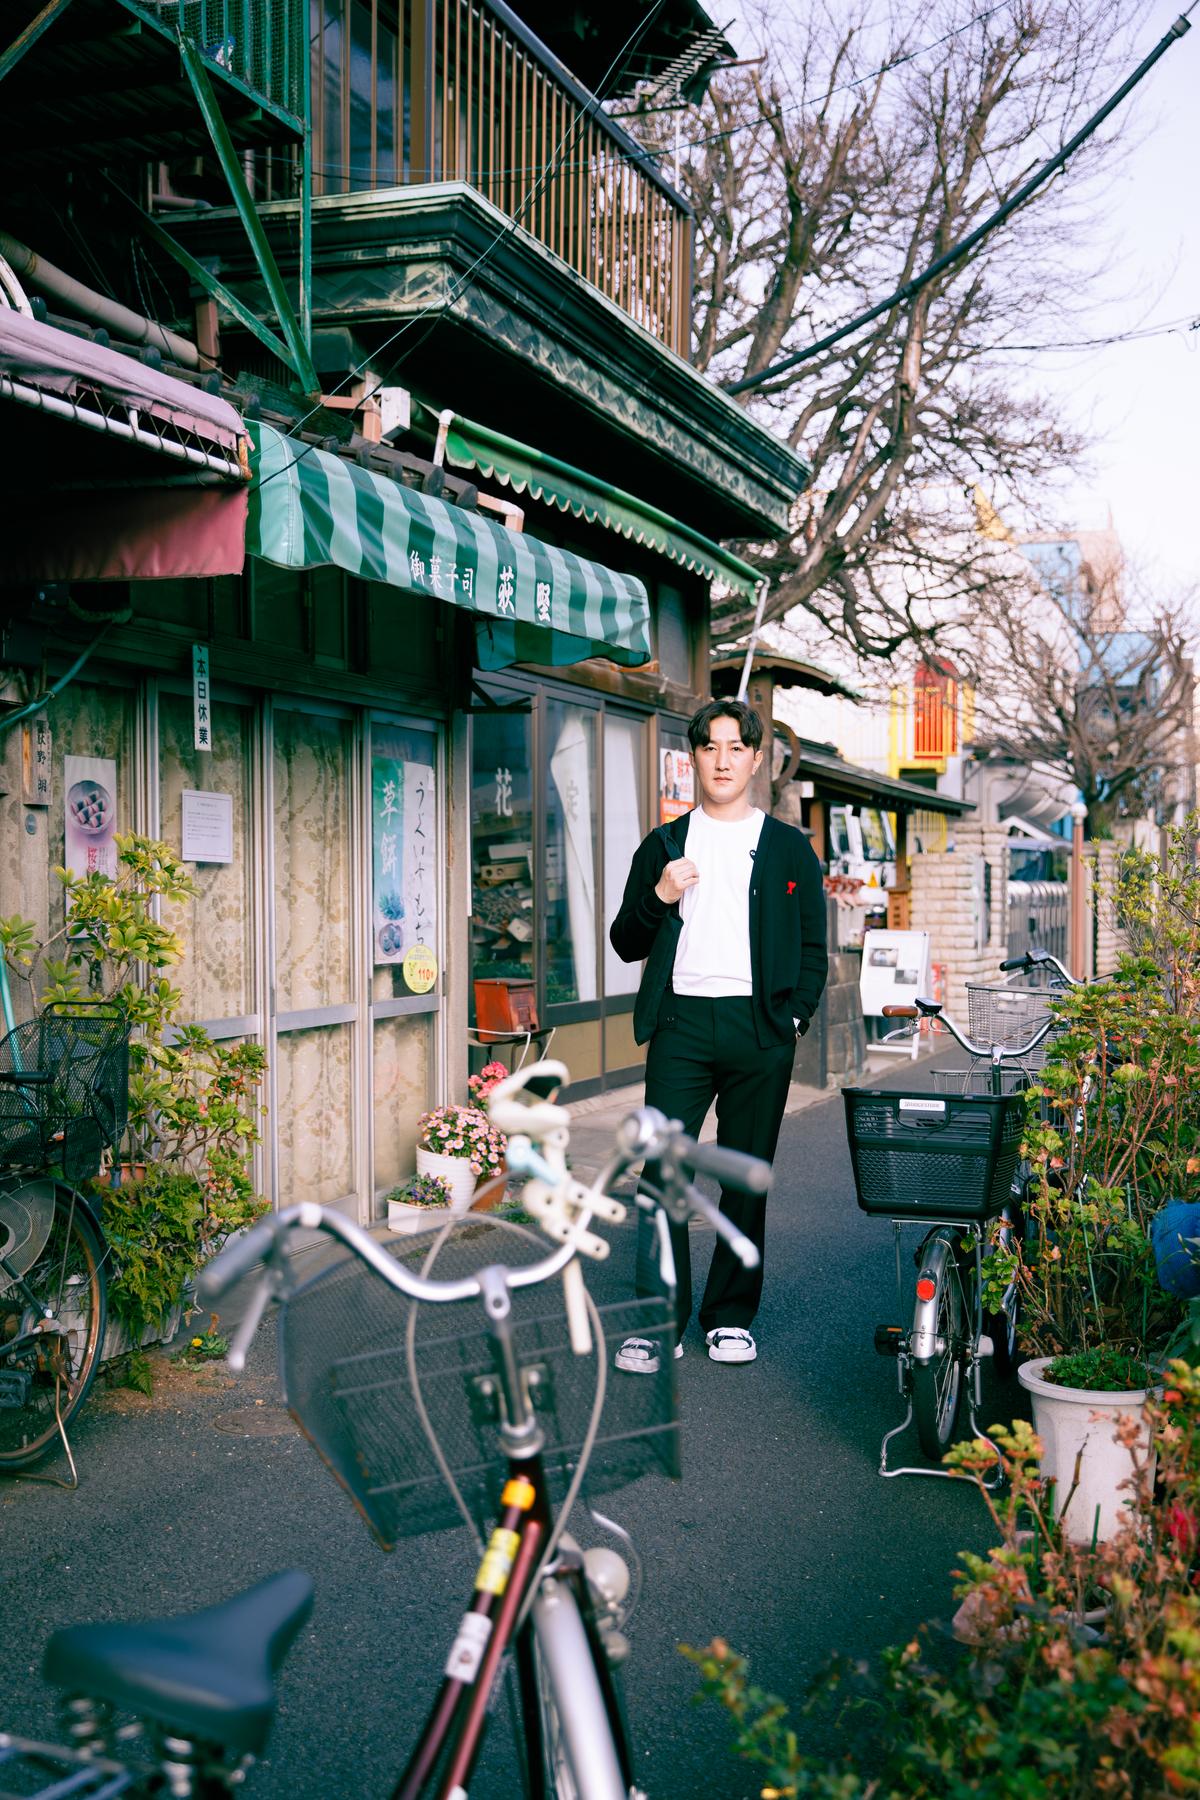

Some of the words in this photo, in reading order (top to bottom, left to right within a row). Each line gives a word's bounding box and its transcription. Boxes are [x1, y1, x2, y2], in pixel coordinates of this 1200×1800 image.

[410, 550, 474, 599] 御菓子司
[196, 658, 208, 744] 本日休業
[494, 767, 514, 817] 花
[379, 781, 399, 880] 草餅
